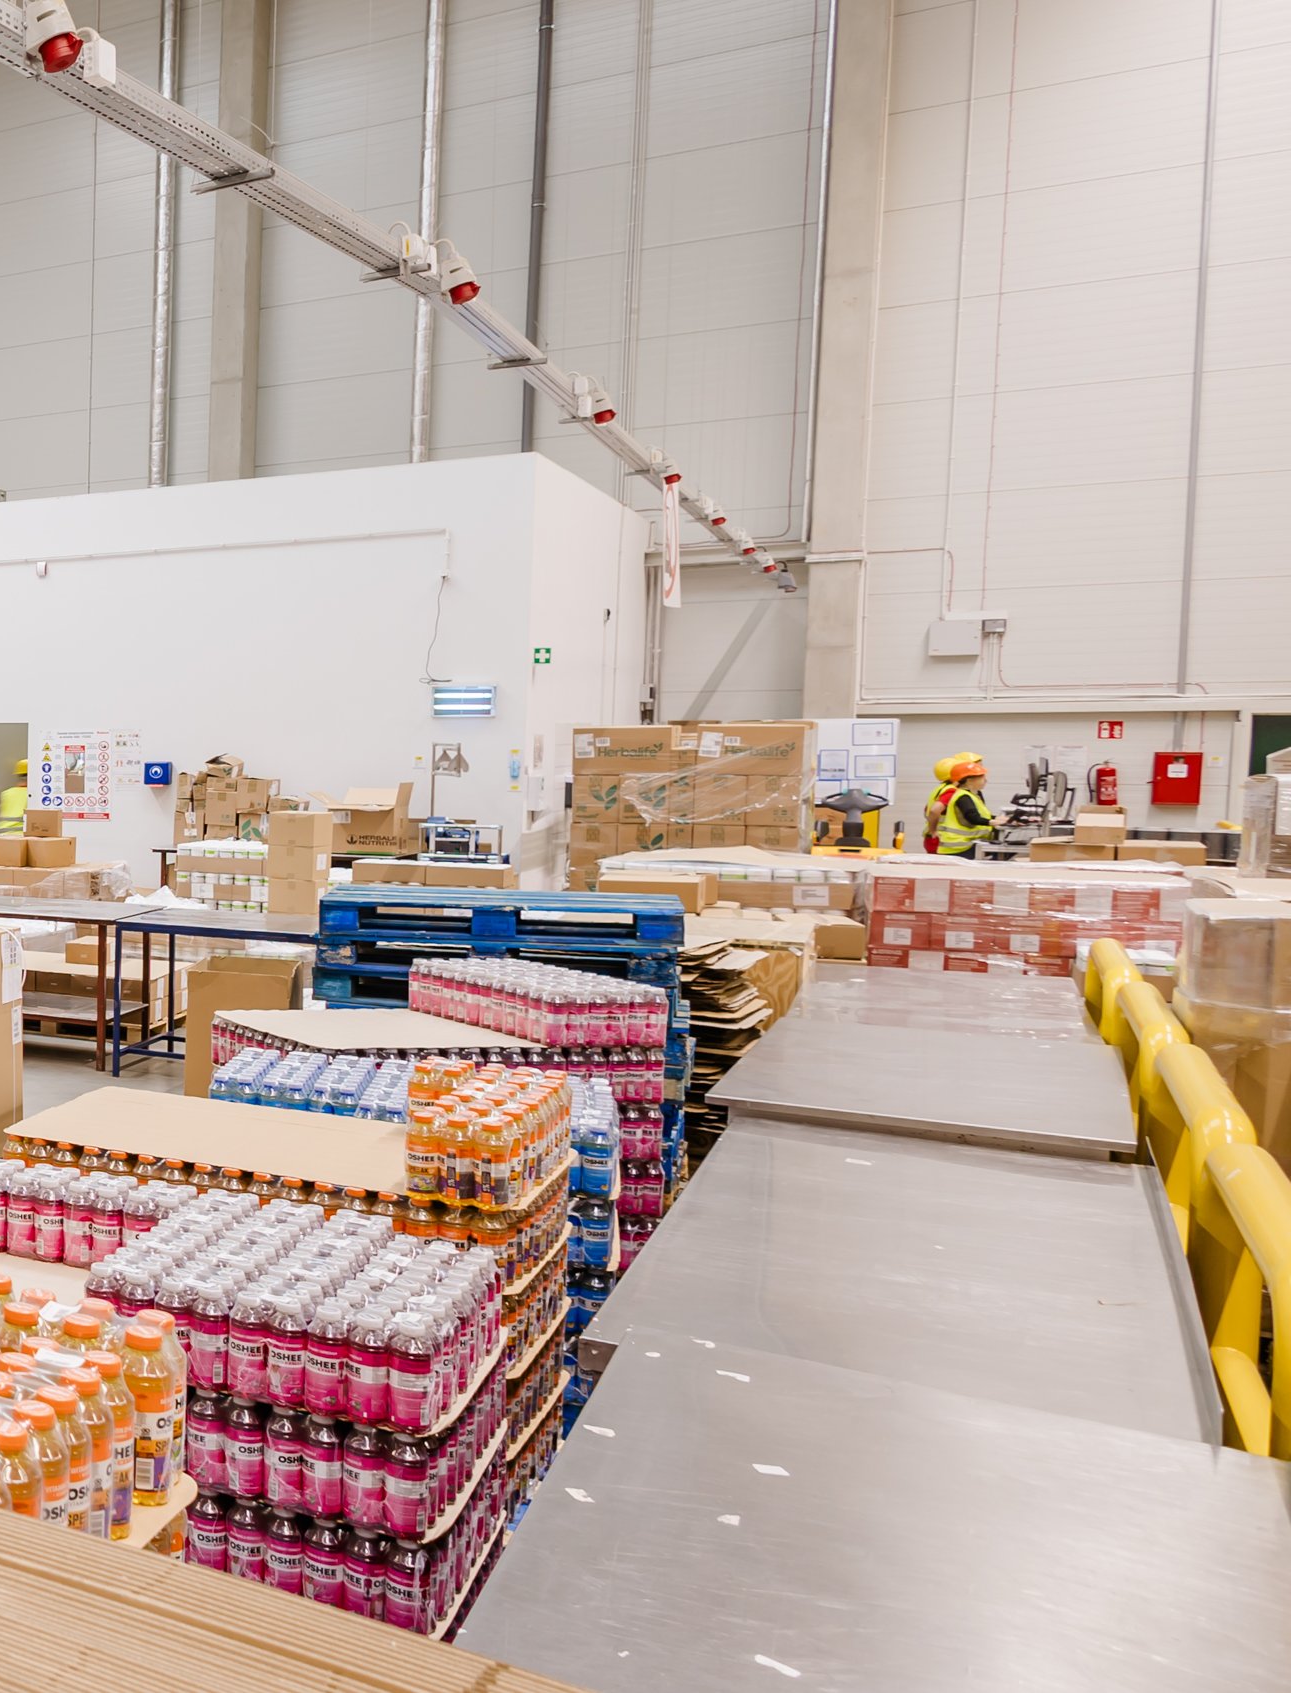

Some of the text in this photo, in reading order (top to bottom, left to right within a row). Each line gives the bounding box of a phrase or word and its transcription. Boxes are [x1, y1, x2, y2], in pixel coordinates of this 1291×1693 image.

[598, 746, 658, 758] Herbalife
[407, 1153, 434, 1162] OSHEE
[9, 1211, 32, 1220] OSHEE
[93, 1227, 117, 1236] OSHEE
[230, 1342, 262, 1355] OSHEE
[229, 1541, 261, 1556] OSHEE
[305, 1561, 337, 1577] OSHEE
